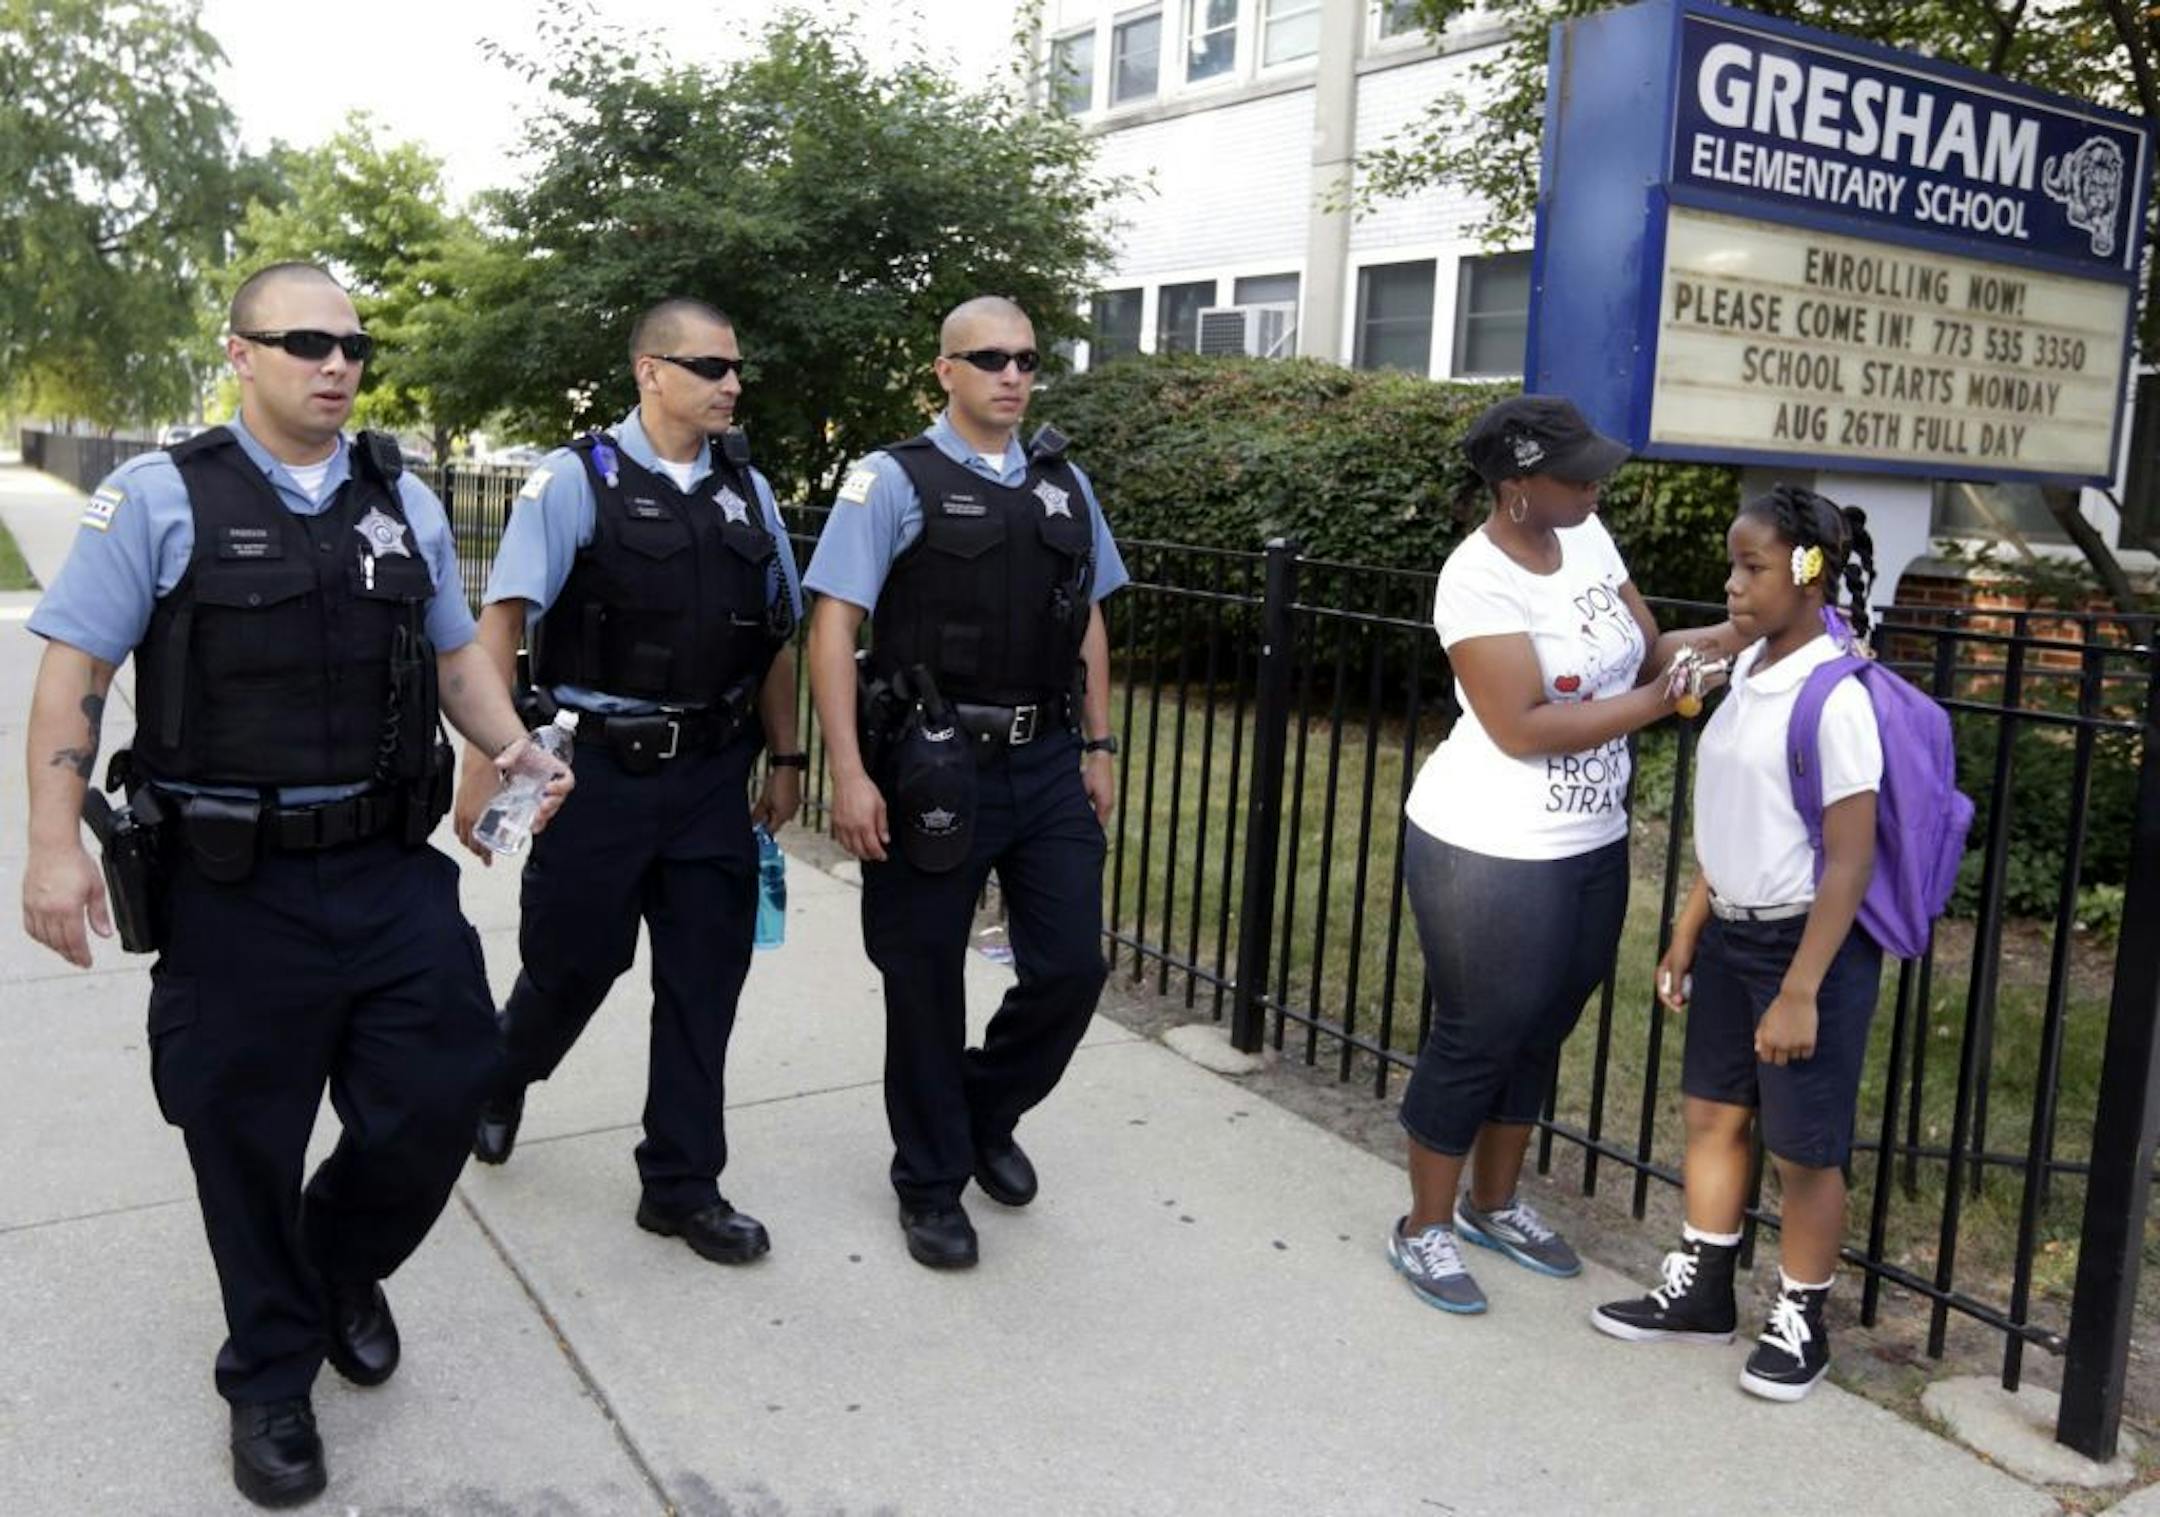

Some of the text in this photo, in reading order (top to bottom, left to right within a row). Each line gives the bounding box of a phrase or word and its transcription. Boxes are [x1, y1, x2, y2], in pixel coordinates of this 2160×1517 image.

[1698, 42, 2040, 191] GRESHAM
[1691, 132, 2029, 239] ELEMENTARY SCHOOL
[1804, 247, 2028, 317] ENROLLING NOW!
[1674, 281, 2087, 372] PLEASE COME IN! 773 535 3350
[1742, 346, 2060, 416] SCHOOL STARTS MONDAY
[1773, 402, 2026, 457] AUG 26TH FULL DAY
[1545, 783, 1621, 814] STRA
[1546, 755, 1623, 784] FROM
